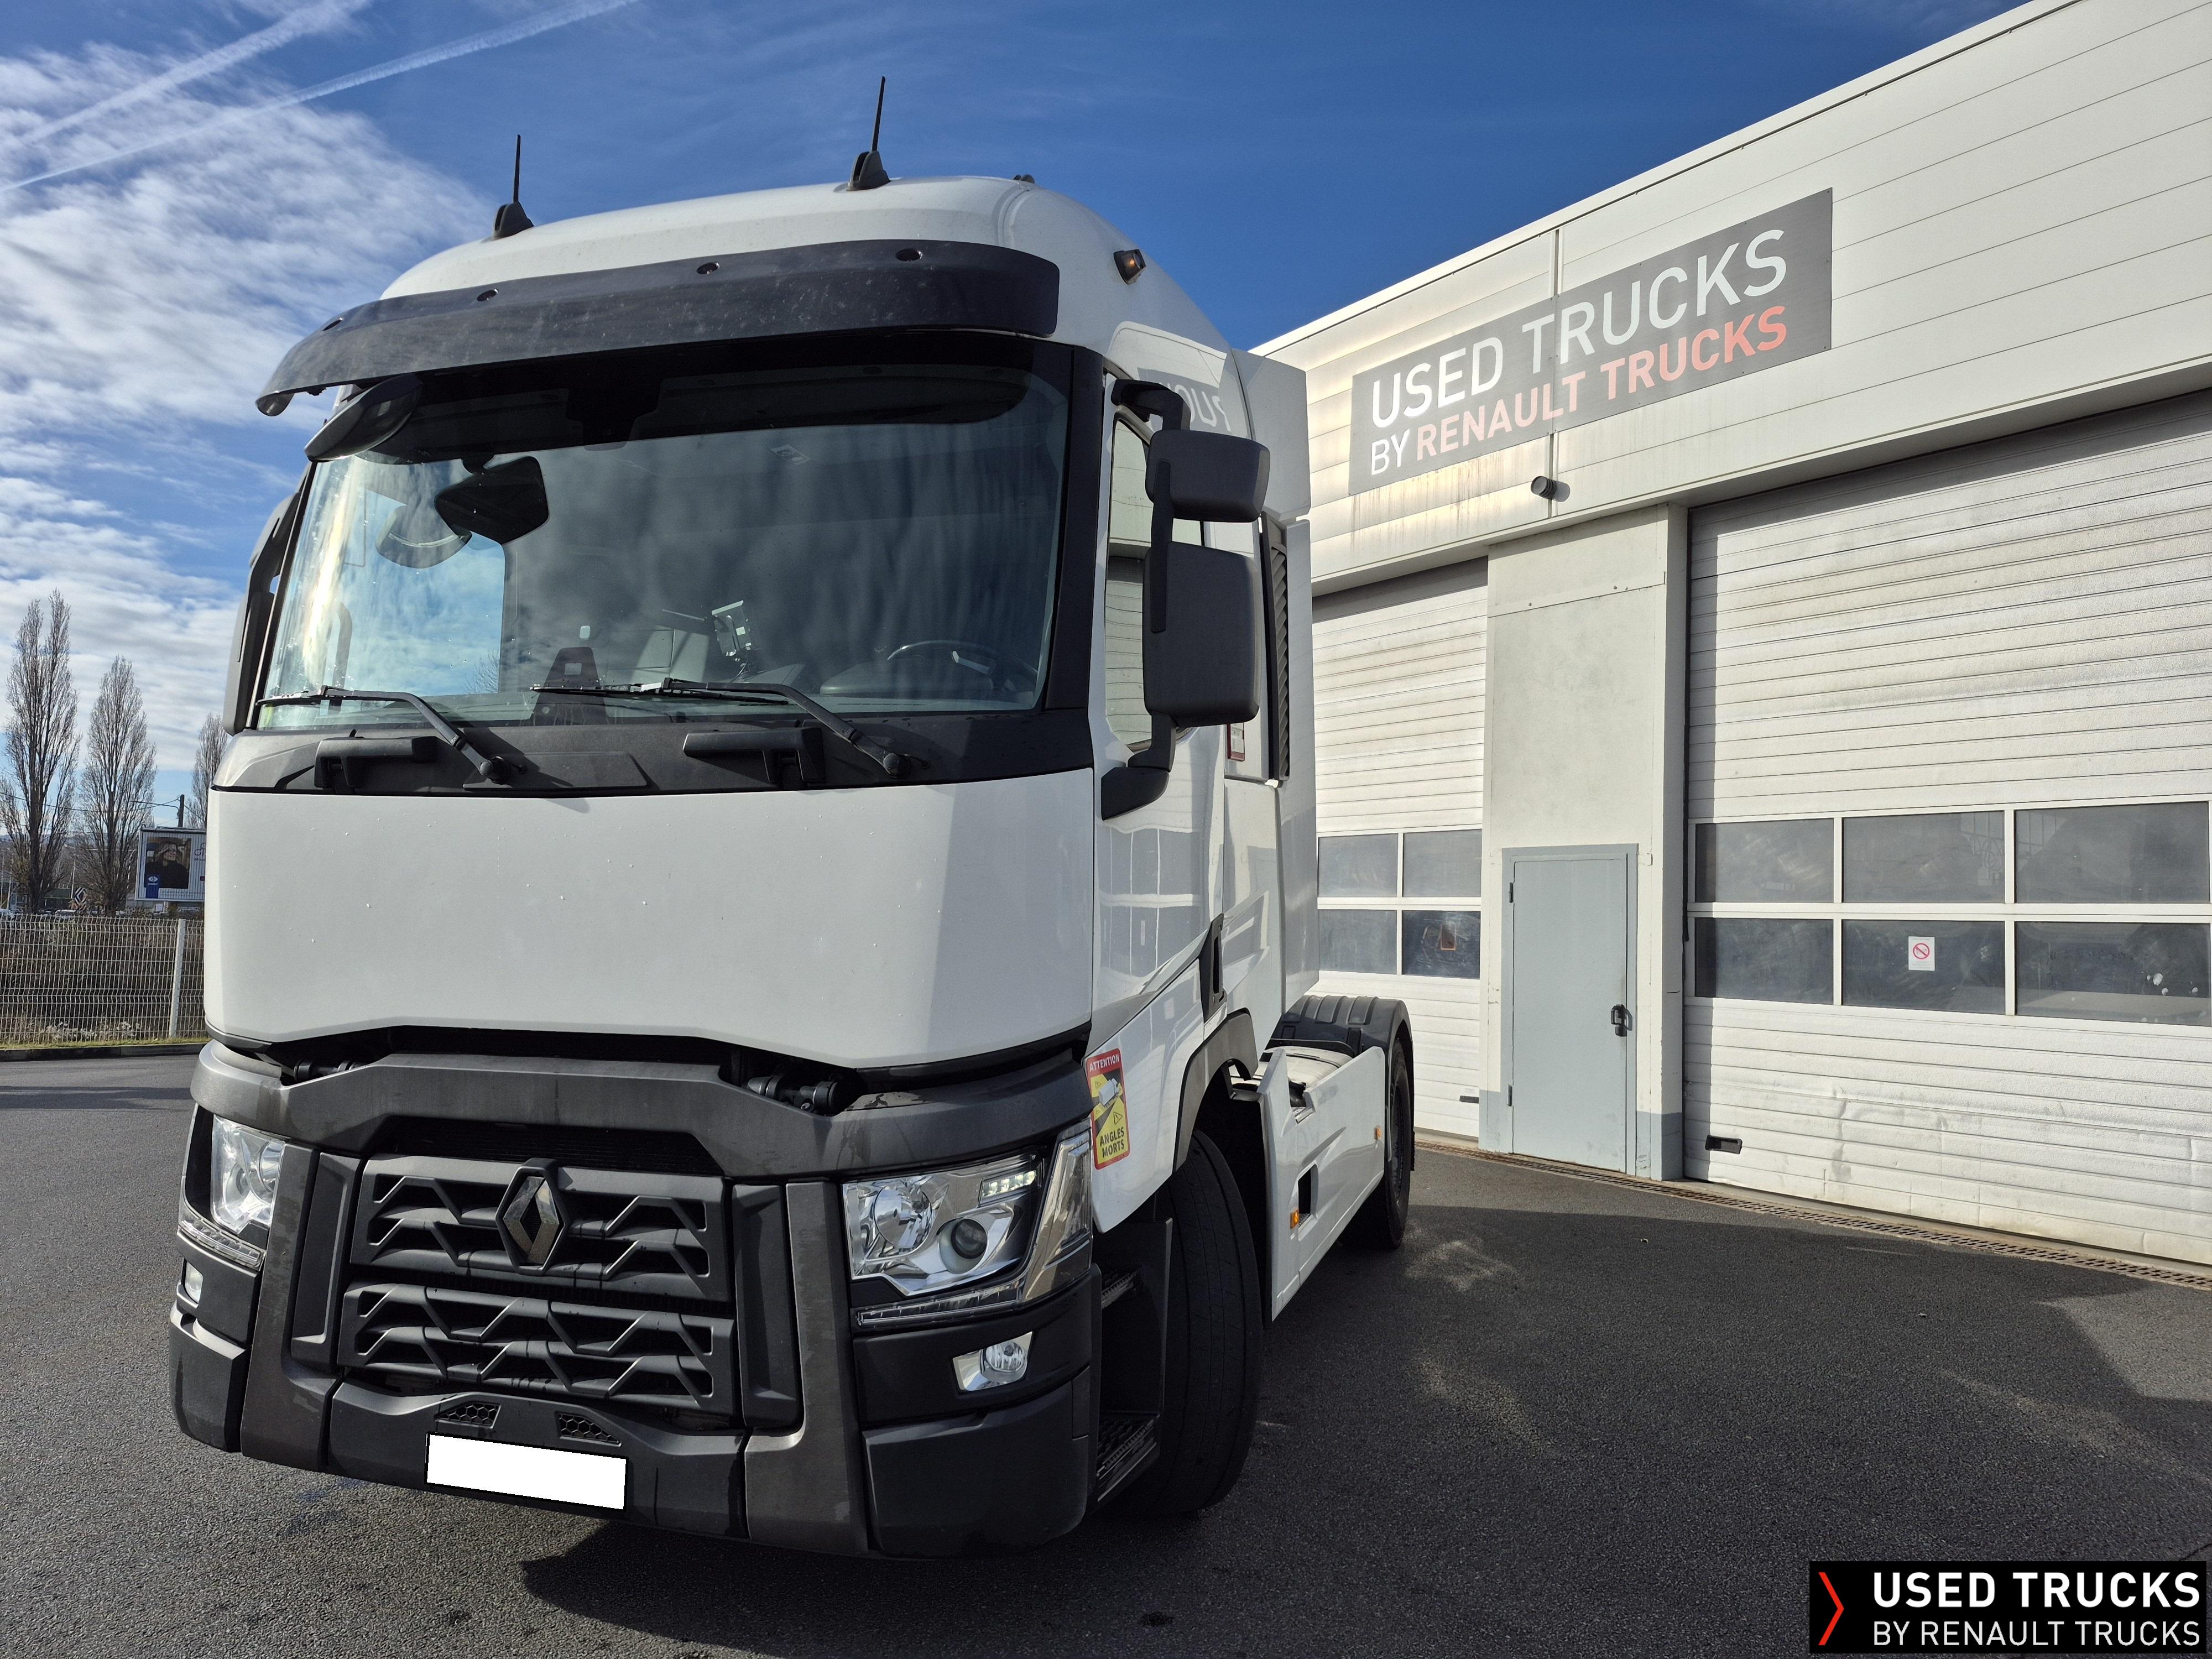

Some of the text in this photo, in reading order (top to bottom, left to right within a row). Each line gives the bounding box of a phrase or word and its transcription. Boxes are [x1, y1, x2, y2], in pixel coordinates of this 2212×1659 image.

[1371, 336, 1503, 428] USED
[1522, 229, 1787, 374] TRUCKS
[1370, 305, 1787, 476] BY RENAULT TRUCKS
[1089, 1053, 1120, 1072] ATTENTION
[1099, 1126, 1125, 1147] ANGLES
[1102, 1139, 1125, 1158] MORTS
